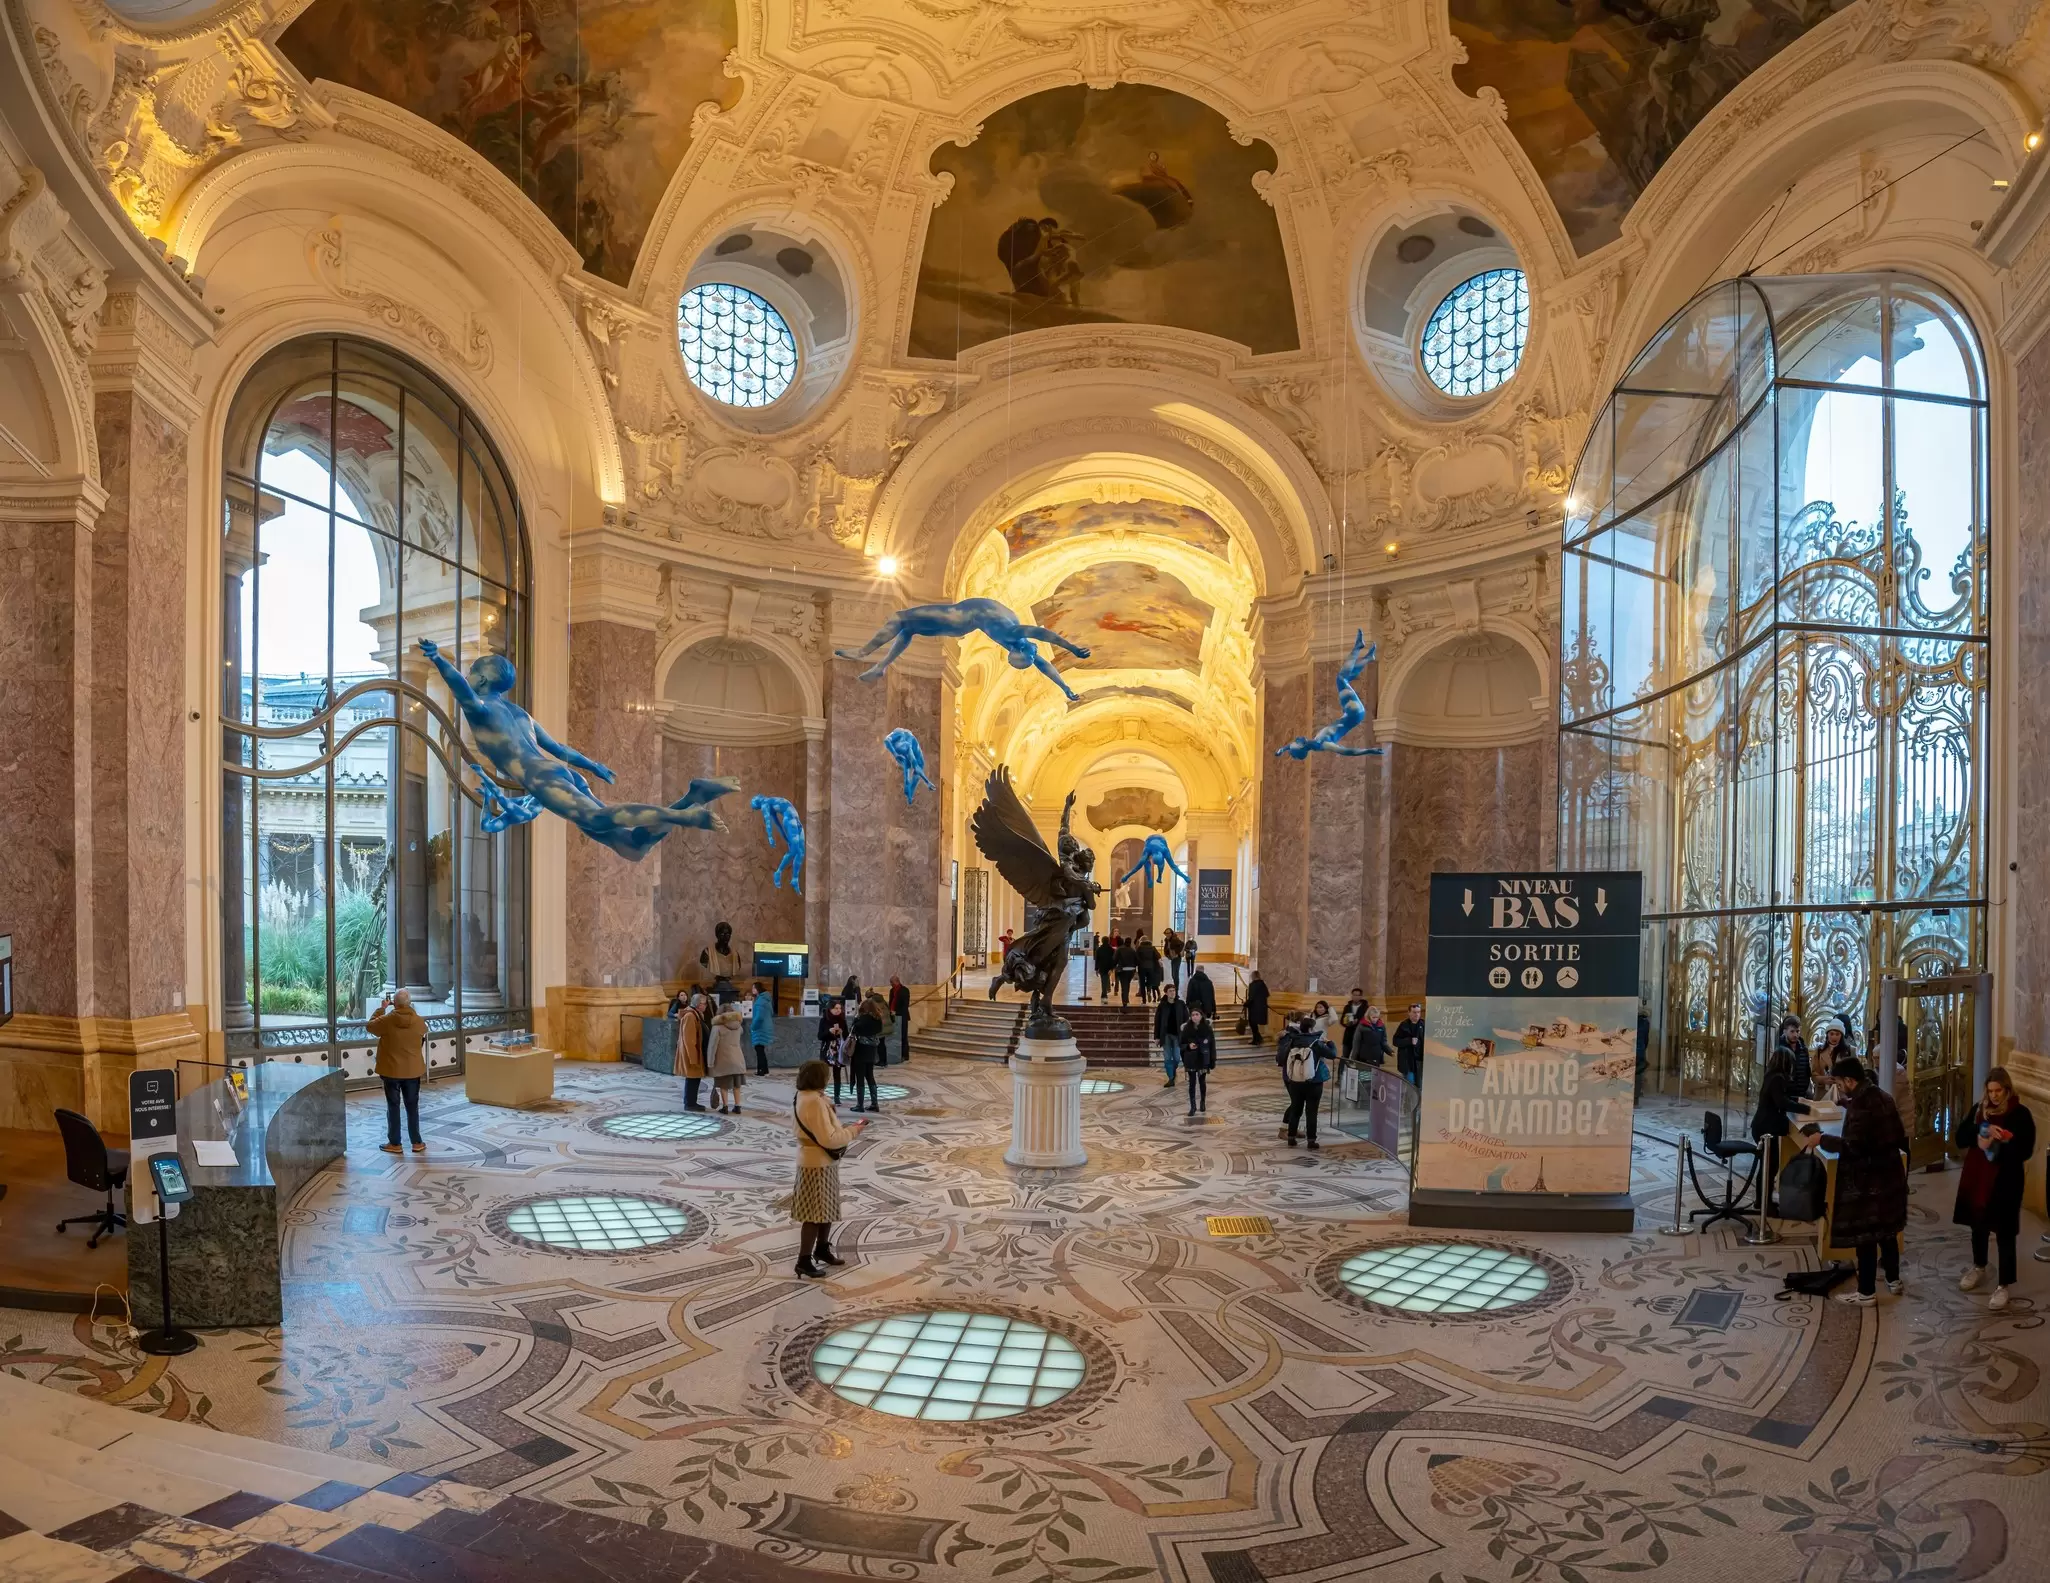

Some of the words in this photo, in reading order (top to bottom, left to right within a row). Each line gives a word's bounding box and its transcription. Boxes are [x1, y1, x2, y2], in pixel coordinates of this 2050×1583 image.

[1498, 880, 1573, 895] NIVEAU
[1489, 896, 1580, 929] BAS
[1489, 944, 1581, 962] SORTIE
[1435, 1004, 1442, 1013] 9
[1456, 1015, 1474, 1026] déc.
[1432, 1028, 1459, 1039] 2022
[1438, 1127, 1452, 1140] DE
[1461, 1126, 1506, 1147] VERTIGES
